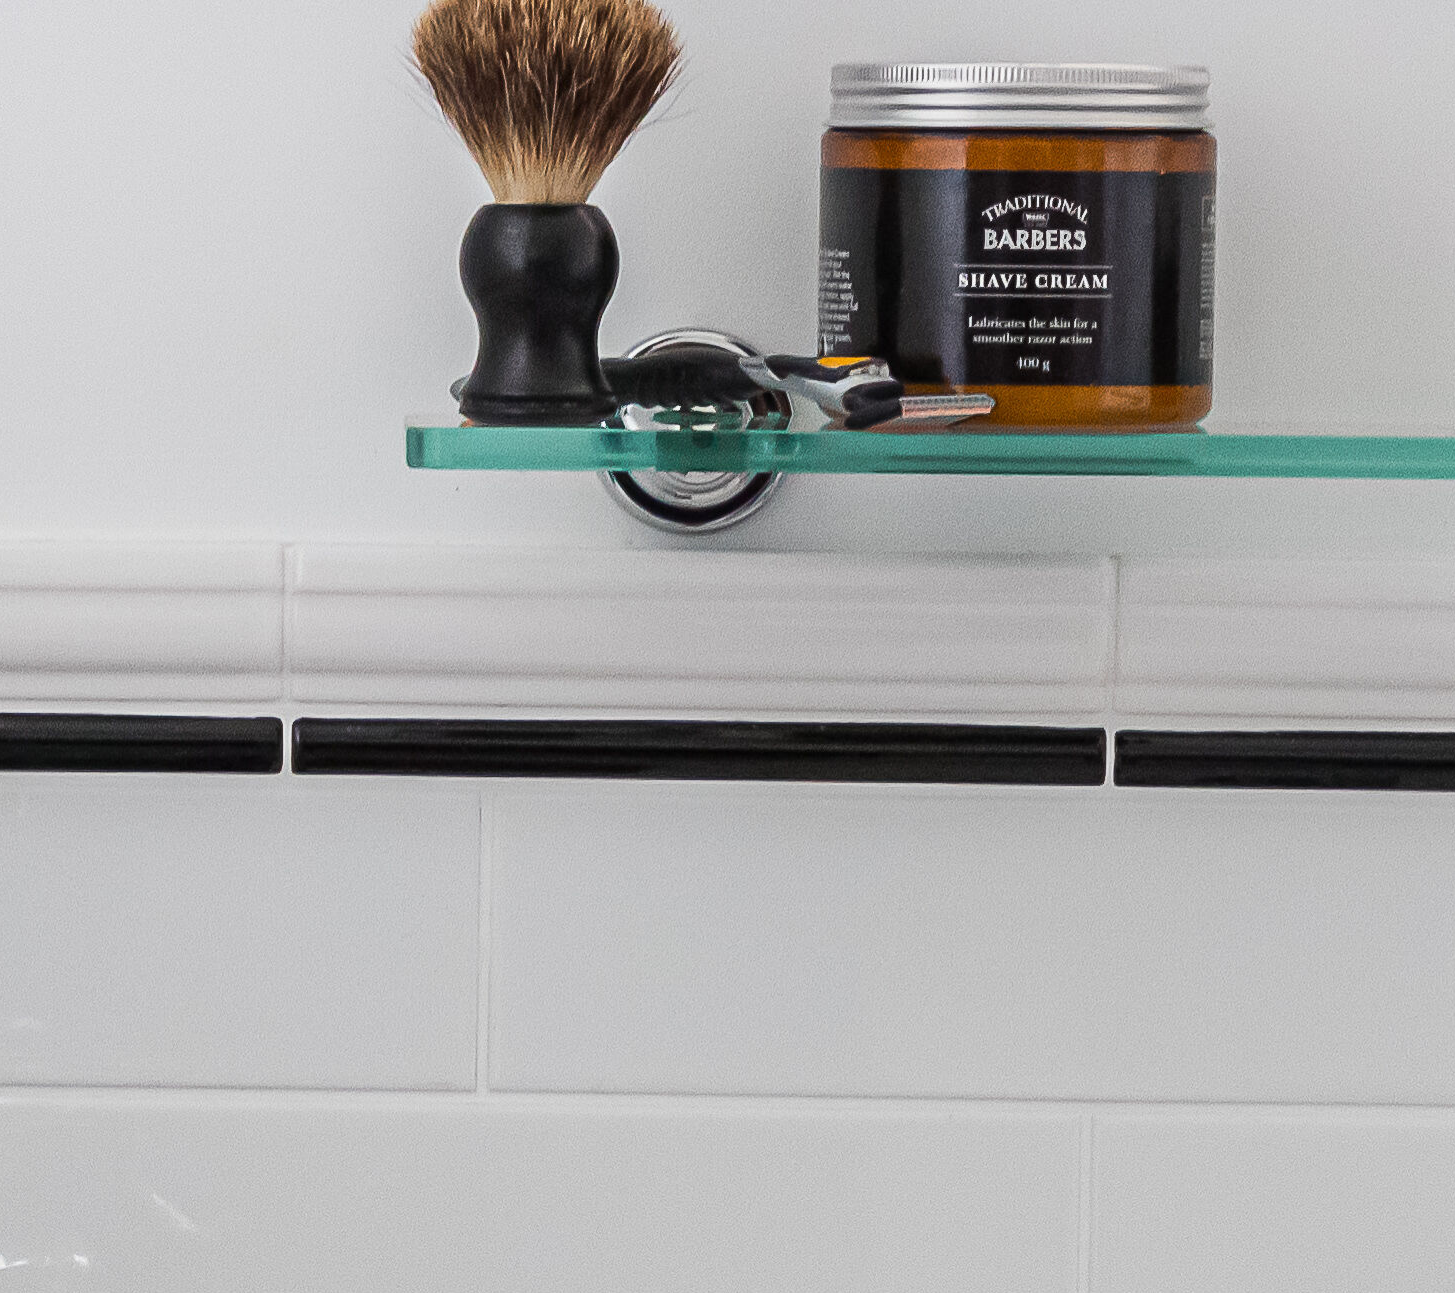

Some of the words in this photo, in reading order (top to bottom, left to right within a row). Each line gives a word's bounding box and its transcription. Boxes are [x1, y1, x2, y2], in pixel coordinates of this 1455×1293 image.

[981, 194, 1089, 225] TRADITIONAL
[983, 228, 1087, 251] BARBERS
[958, 273, 1028, 289] SHAVE
[1034, 273, 1109, 289] CREAM
[968, 316, 1026, 329] Lubricates
[1028, 316, 1046, 329] the
[1049, 316, 1071, 329] skin
[1073, 316, 1088, 329] for
[1091, 321, 1098, 329] a
[972, 332, 1024, 344] smoother
[1027, 335, 1056, 344] razor
[1059, 333, 1093, 344] action
[1042, 358, 1051, 372] g
